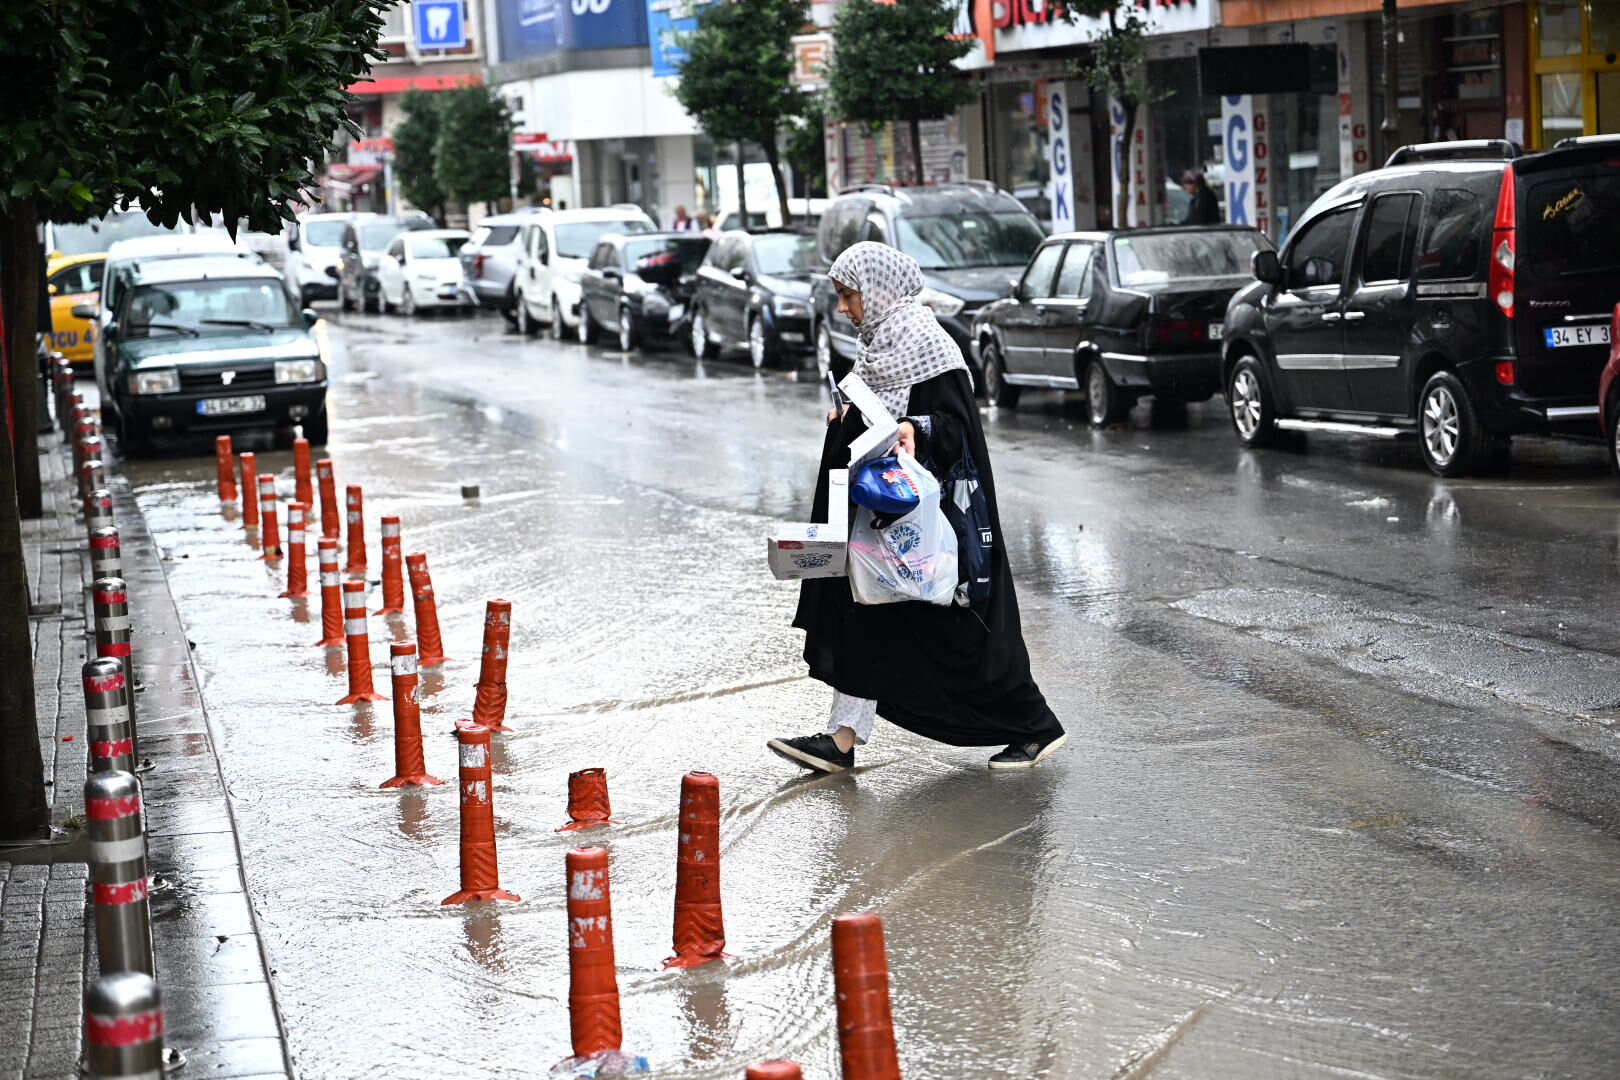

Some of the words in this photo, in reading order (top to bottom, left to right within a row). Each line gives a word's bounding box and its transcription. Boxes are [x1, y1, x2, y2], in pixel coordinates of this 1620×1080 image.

[1051, 92, 1069, 220] SGK
[1226, 95, 1249, 225] GK
[1553, 329, 1570, 345] 34
[1576, 327, 1592, 343] EY
